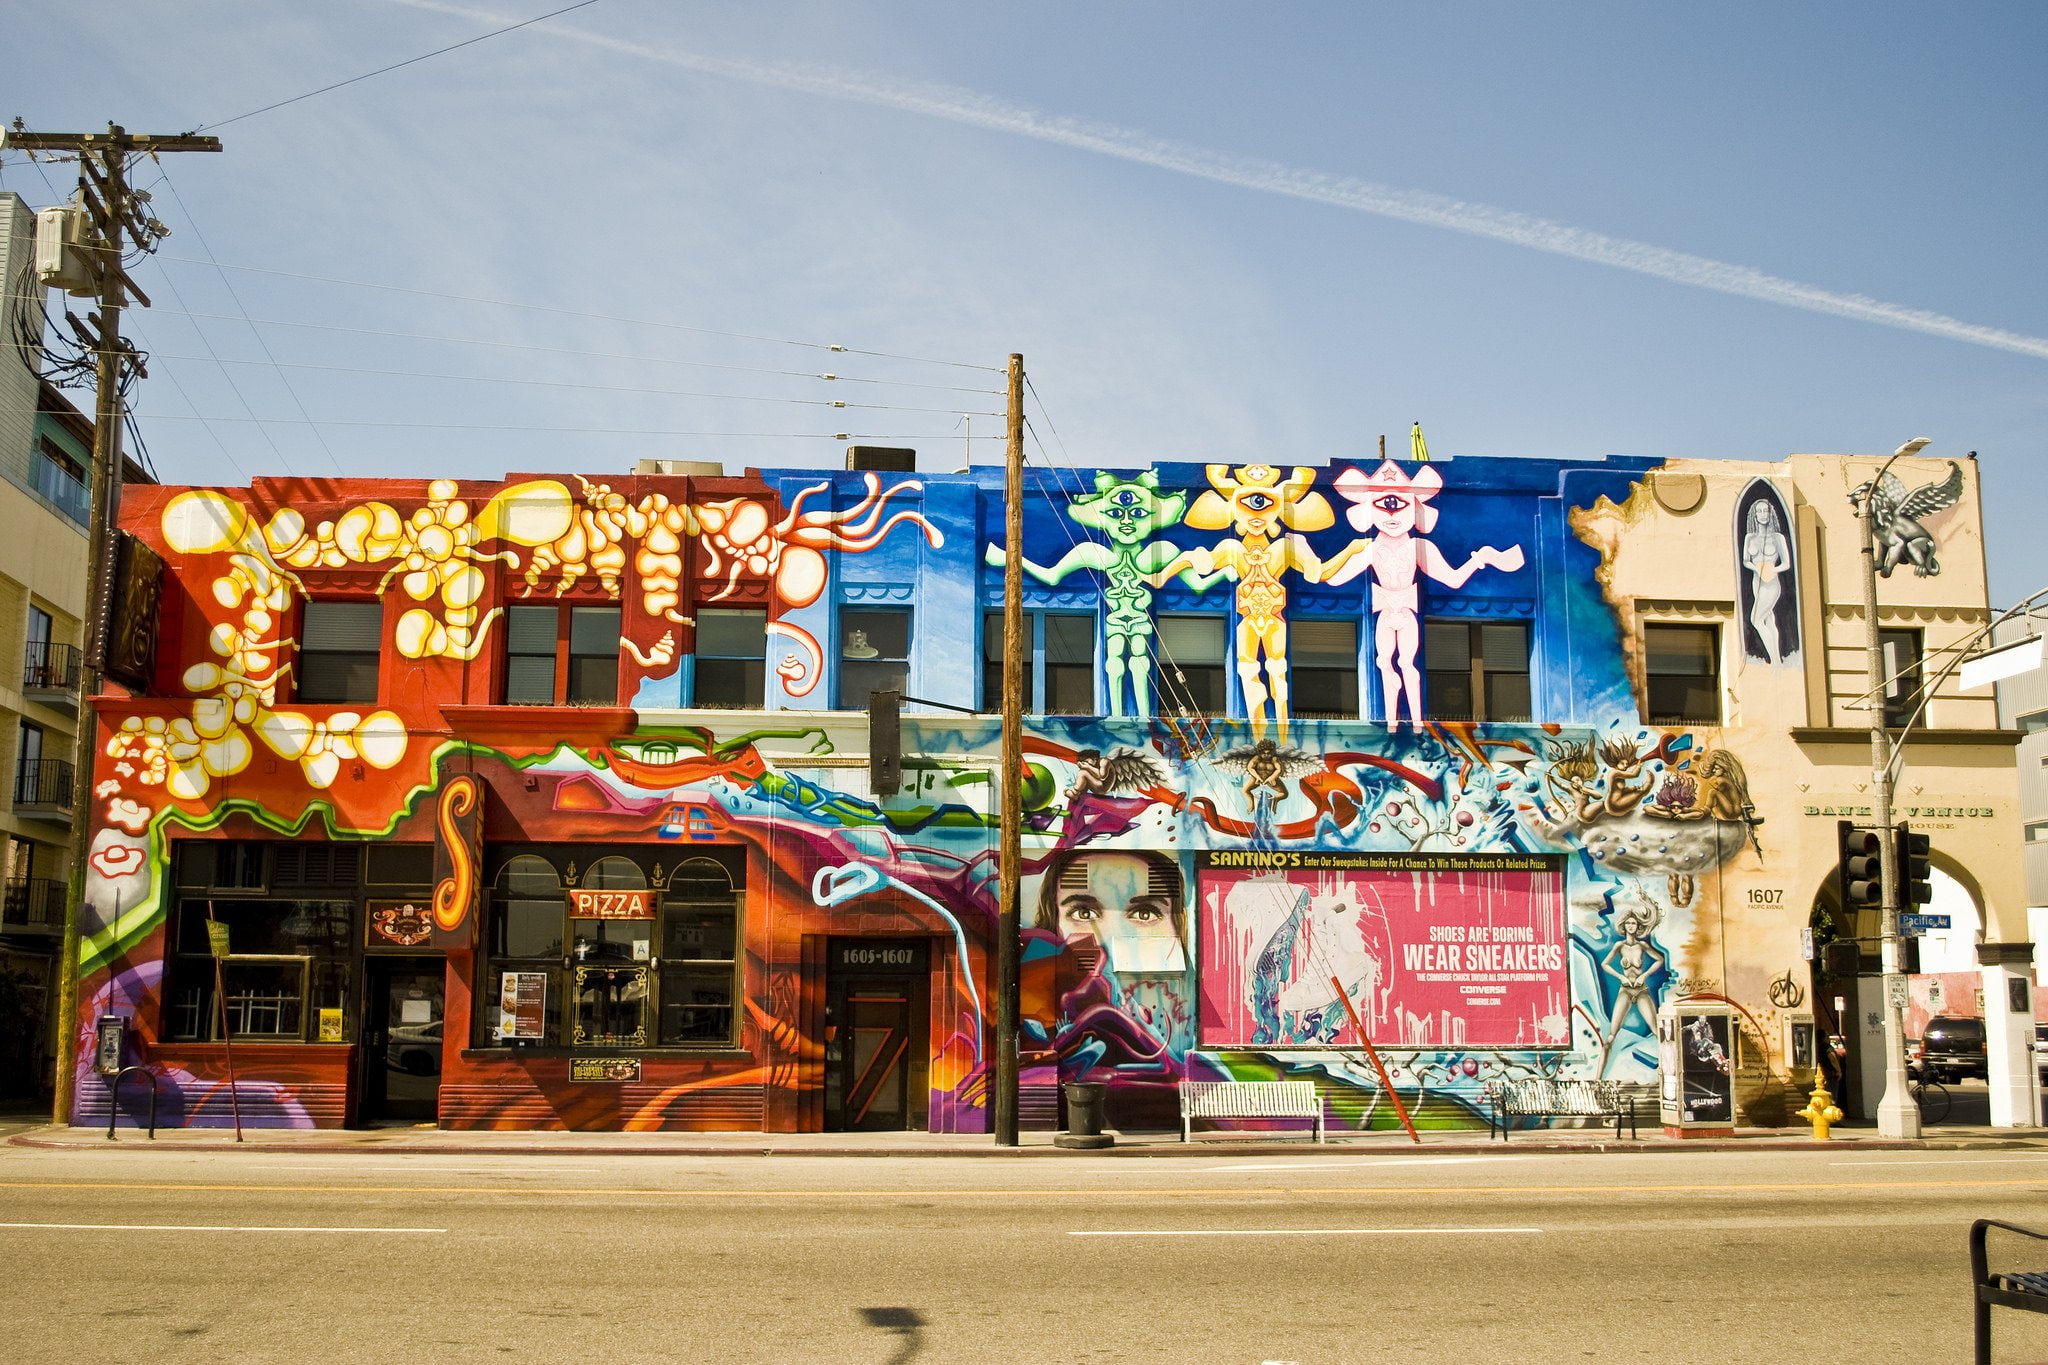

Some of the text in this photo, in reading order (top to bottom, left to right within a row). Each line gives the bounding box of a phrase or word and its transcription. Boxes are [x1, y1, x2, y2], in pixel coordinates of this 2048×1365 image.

[1803, 805, 1872, 816] BANK
[1903, 807, 1994, 817] VENICE
[1209, 851, 1547, 869] SANTINO'S Enter Our Sweepstakes Inside For A Chance To Win These Products Or Related Prizes
[1747, 889, 1783, 903] 1607
[578, 894, 645, 915] PIZZA
[1903, 915, 1933, 926] Pacific
[1429, 926, 1534, 942] SHOES ARE BORING
[637, 944, 646, 954] A
[843, 949, 914, 964] 1605-1607
[1403, 944, 1562, 971] WEAR SNEAKERS
[1416, 973, 1426, 982] THE
[1426, 973, 1453, 982] CONVERSE
[1453, 973, 1470, 982] CHUCK
[1489, 973, 1497, 982] ALL
[1497, 973, 1510, 982] STAR
[1510, 973, 1535, 982] PLATFORM
[1536, 973, 1549, 982] PLUS
[1459, 985, 1507, 994] CONVERSE
[1466, 997, 1501, 1006] CONVERSE.COM
[1690, 1098, 1723, 1106] HOLLYWOOD
